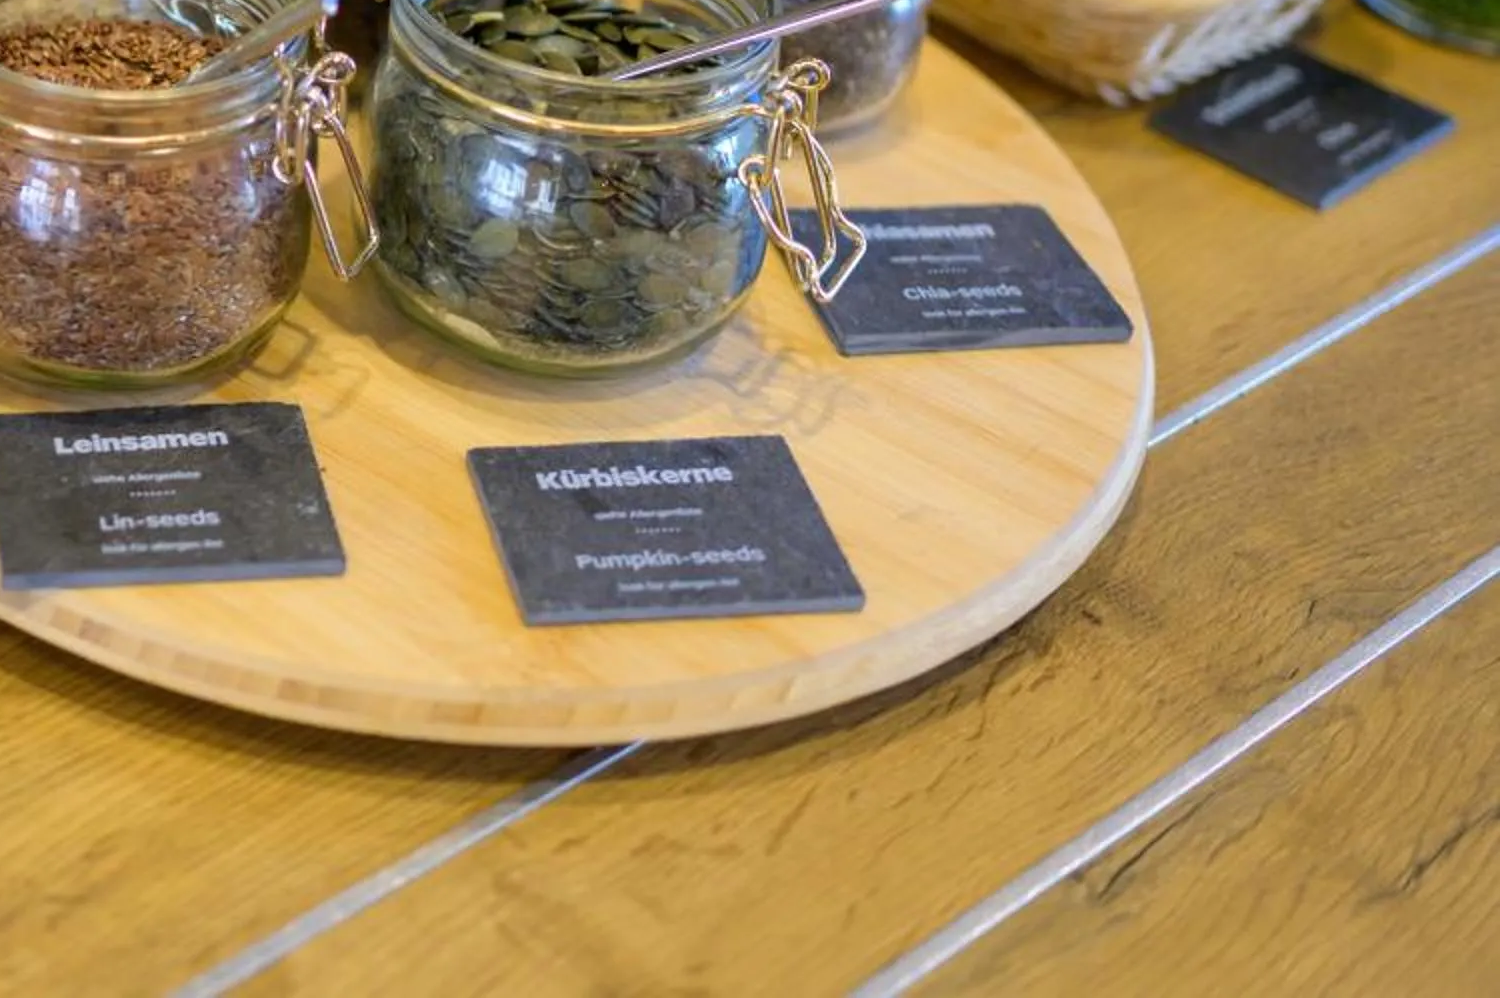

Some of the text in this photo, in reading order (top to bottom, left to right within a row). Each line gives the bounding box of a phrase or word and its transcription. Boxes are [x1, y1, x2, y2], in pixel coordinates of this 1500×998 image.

[843, 222, 996, 241] hiasamen
[902, 282, 1024, 301] Chia-seeds
[53, 429, 229, 455] Leinsamen
[535, 465, 733, 490] Kürbiskerne
[99, 508, 221, 532] Lin-seeds
[575, 544, 767, 570] Pumpkin-seeds
